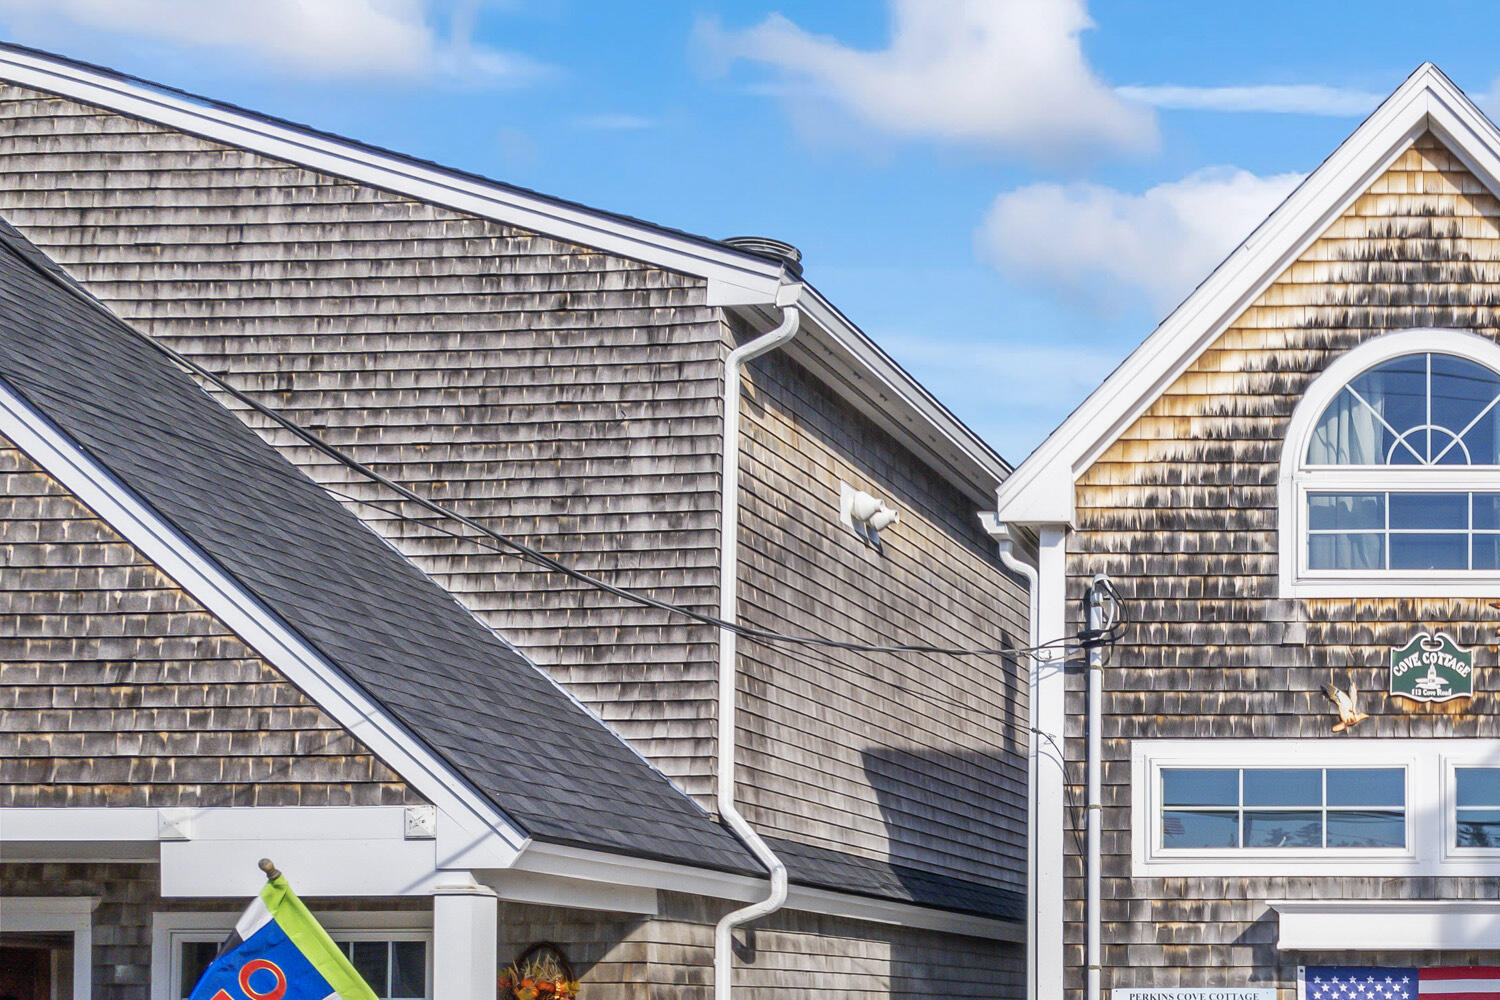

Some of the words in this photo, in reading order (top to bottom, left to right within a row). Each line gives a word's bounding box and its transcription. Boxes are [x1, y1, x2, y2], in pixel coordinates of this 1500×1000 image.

[1393, 651, 1423, 677] COVE
[1422, 651, 1471, 678] COTTAGE
[1129, 993, 1174, 1000] PERKINS
[1177, 993, 1206, 1000] COVE
[1209, 993, 1260, 1000] COTTAGE
